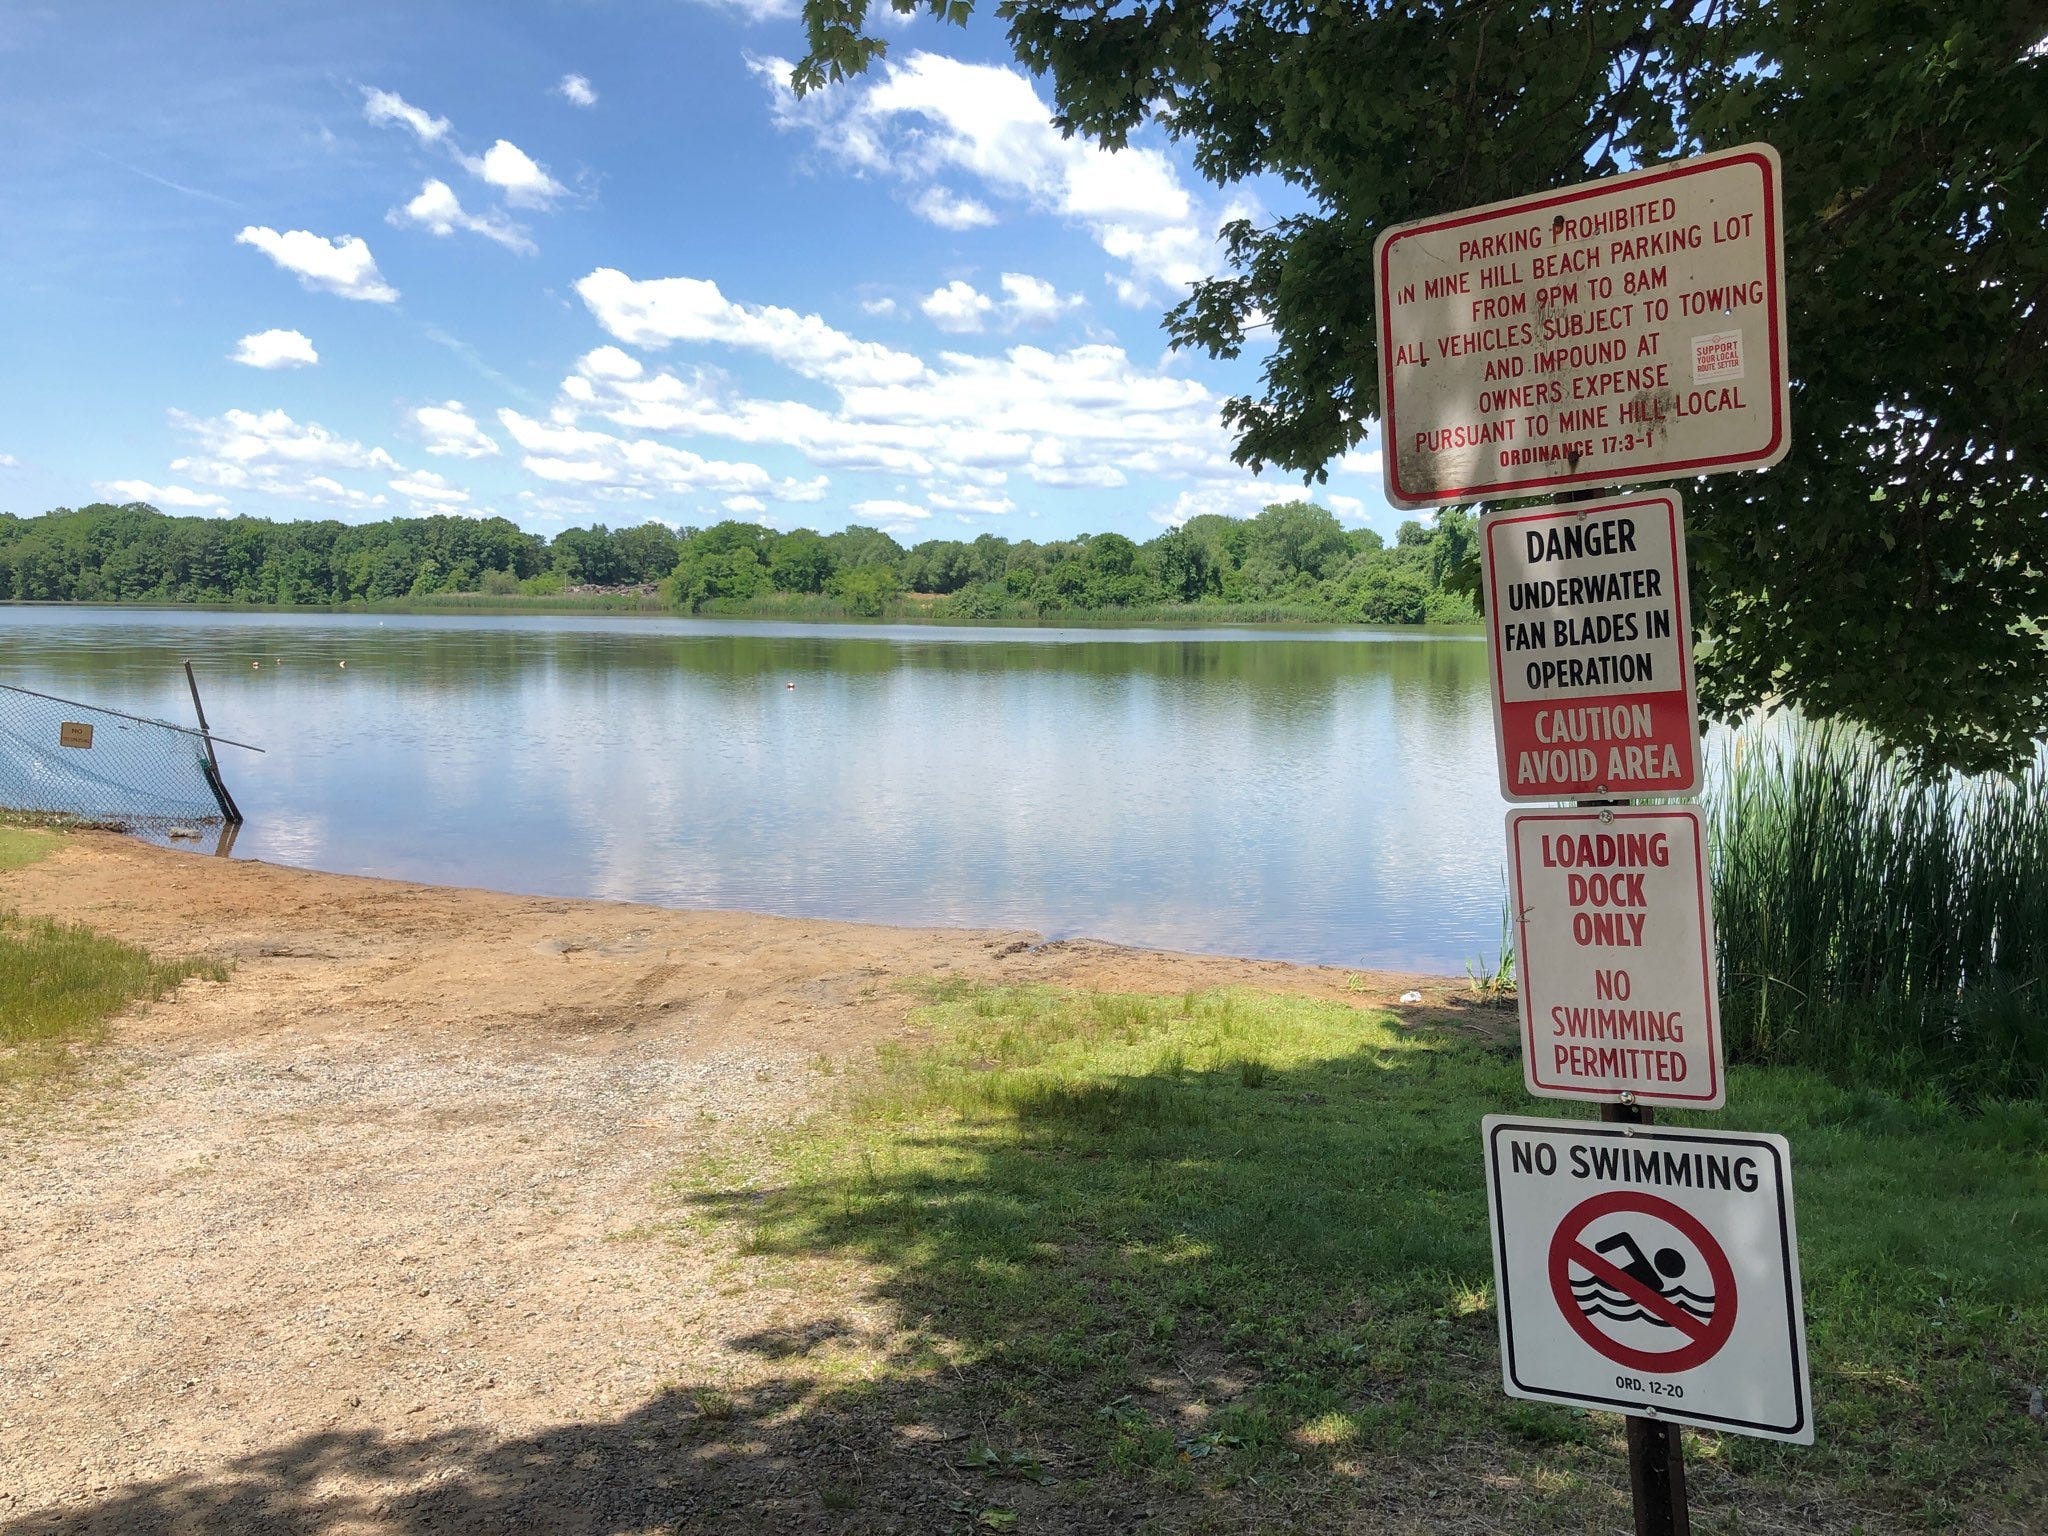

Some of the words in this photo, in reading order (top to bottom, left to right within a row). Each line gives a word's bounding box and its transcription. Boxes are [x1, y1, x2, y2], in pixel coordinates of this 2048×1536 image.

[1459, 226, 1542, 263] PARKING
[1552, 197, 1676, 245] PROHIBITED
[1397, 283, 1415, 305] IN
[1424, 271, 1471, 300] MINE
[1480, 262, 1523, 289] HILL
[1532, 246, 1600, 280] BEACH
[1610, 224, 1702, 264] PARKING
[1713, 213, 1753, 244] LOT
[1472, 292, 1526, 322] FROM
[1536, 282, 1578, 309] 9PM
[1587, 276, 1612, 301] TO
[1623, 265, 1667, 294] 8AM
[1396, 341, 1430, 366] ALL
[1438, 322, 1532, 358] VEHICLES
[1543, 304, 1633, 341] SUBJECT
[1643, 298, 1669, 323] TO
[1678, 280, 1763, 317] TOWING
[1484, 356, 1524, 382] AND
[1533, 338, 1627, 374] IMPOUND
[1637, 332, 1660, 358] AT
[1696, 341, 1738, 356] SUPPORT
[1697, 354, 1716, 365] YOUR
[1716, 351, 1739, 362] LOCAL
[1697, 362, 1716, 373] ROUTE
[1717, 359, 1739, 370] SETTER
[1479, 380, 1562, 414] OWNERS
[1572, 363, 1669, 400] EXPENSE
[1415, 418, 1515, 453] PURSUANT
[1524, 414, 1549, 438] TO
[1559, 405, 1609, 433] MINE
[1619, 398, 1666, 425] HILL
[1675, 386, 1746, 417] LOCAL
[1500, 439, 1594, 468] ORDINANCE
[1601, 431, 1653, 454] 17:3-1
[1526, 518, 1637, 564] DANGER
[1508, 568, 1662, 611] UNDERWATER
[1505, 621, 1546, 651] FAN
[1553, 612, 1638, 648] BLADES
[1645, 609, 1670, 640] IN
[1526, 652, 1653, 690] OPERATION
[1534, 703, 1653, 744] CAUTION
[1517, 748, 1598, 785] AVOID
[1607, 743, 1682, 781] AREA
[1541, 832, 1670, 868] LOADING
[1567, 873, 1648, 908] DOCK
[1572, 912, 1647, 946] ONLY
[1595, 969, 1631, 1001] NO
[1551, 1005, 1684, 1043] SWIMMING
[1554, 1044, 1687, 1082] PERMITTED
[1510, 1140, 1557, 1177] NO
[1569, 1144, 1760, 1194] SWIMMING
[1615, 1375, 1646, 1392] ORD.
[1648, 1381, 1684, 1399] 12-20
